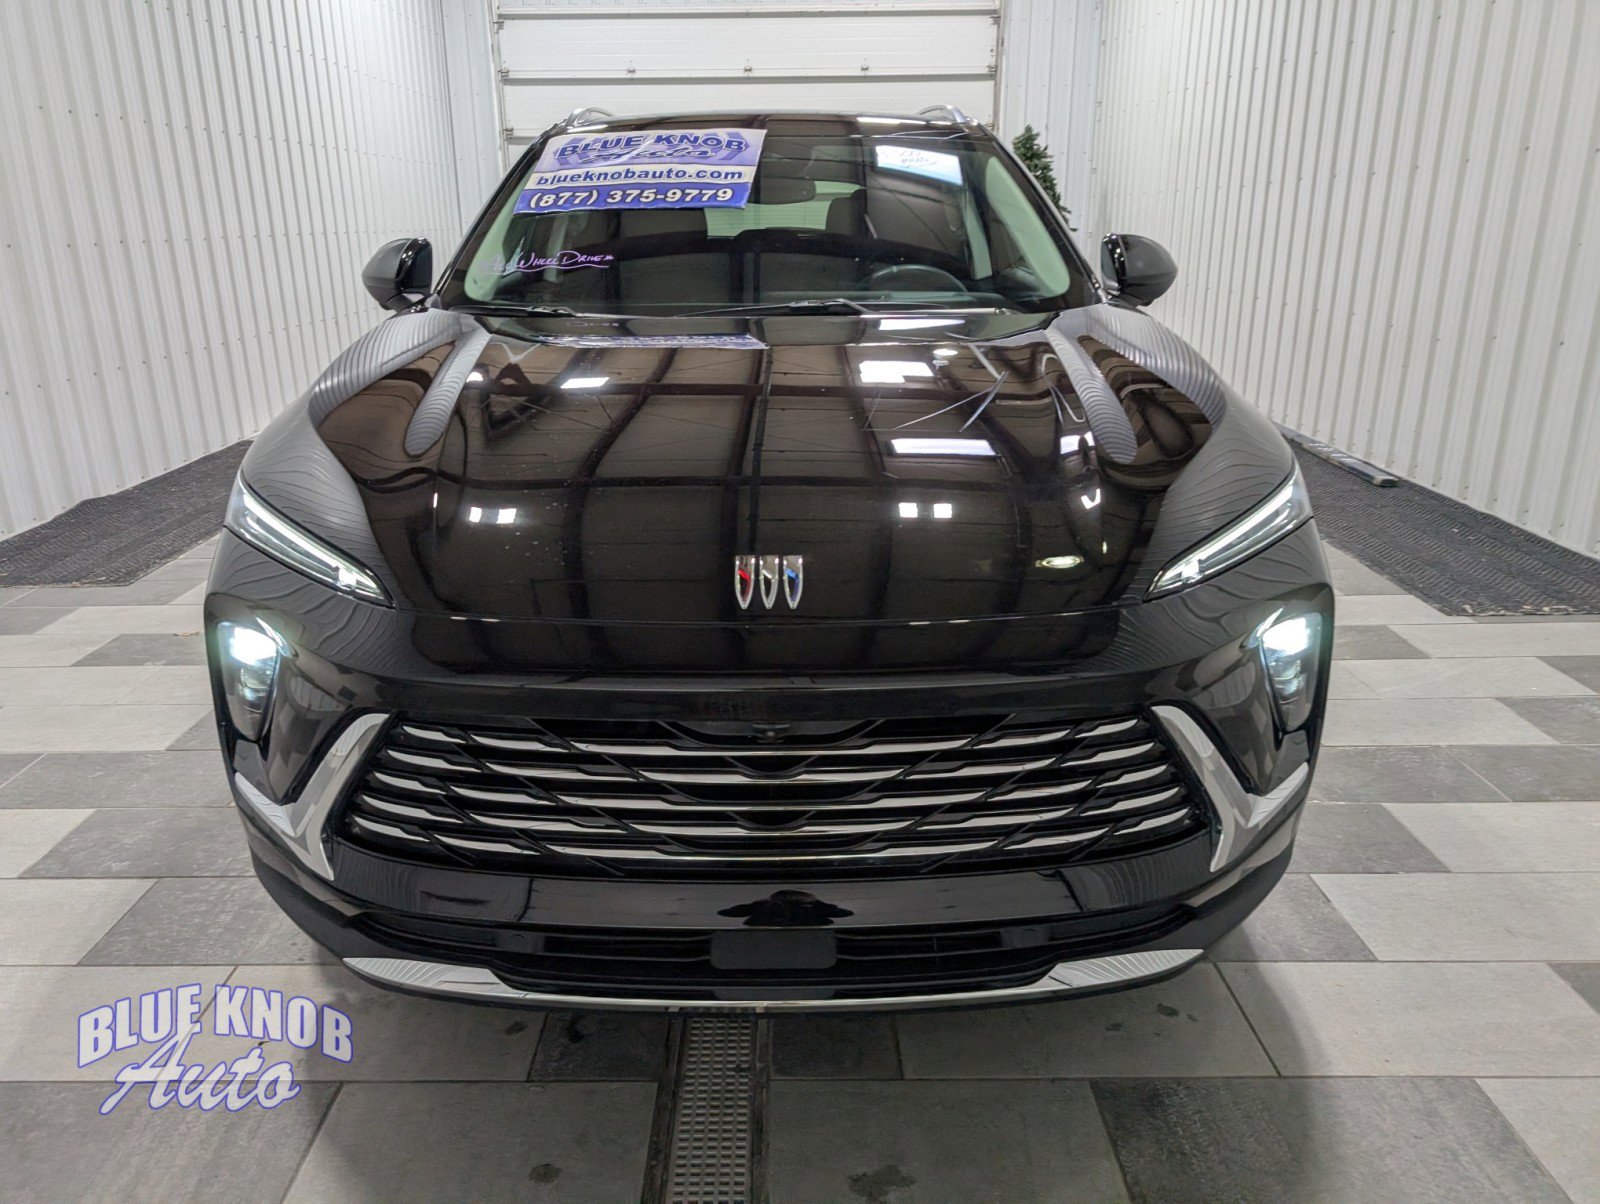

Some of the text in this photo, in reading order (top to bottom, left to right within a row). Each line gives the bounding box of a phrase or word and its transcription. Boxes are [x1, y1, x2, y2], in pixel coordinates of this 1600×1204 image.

[556, 132, 747, 159] BLUE KNOB
[536, 168, 744, 186] blueknobauto.com
[529, 188, 734, 209] (877) 375-9779
